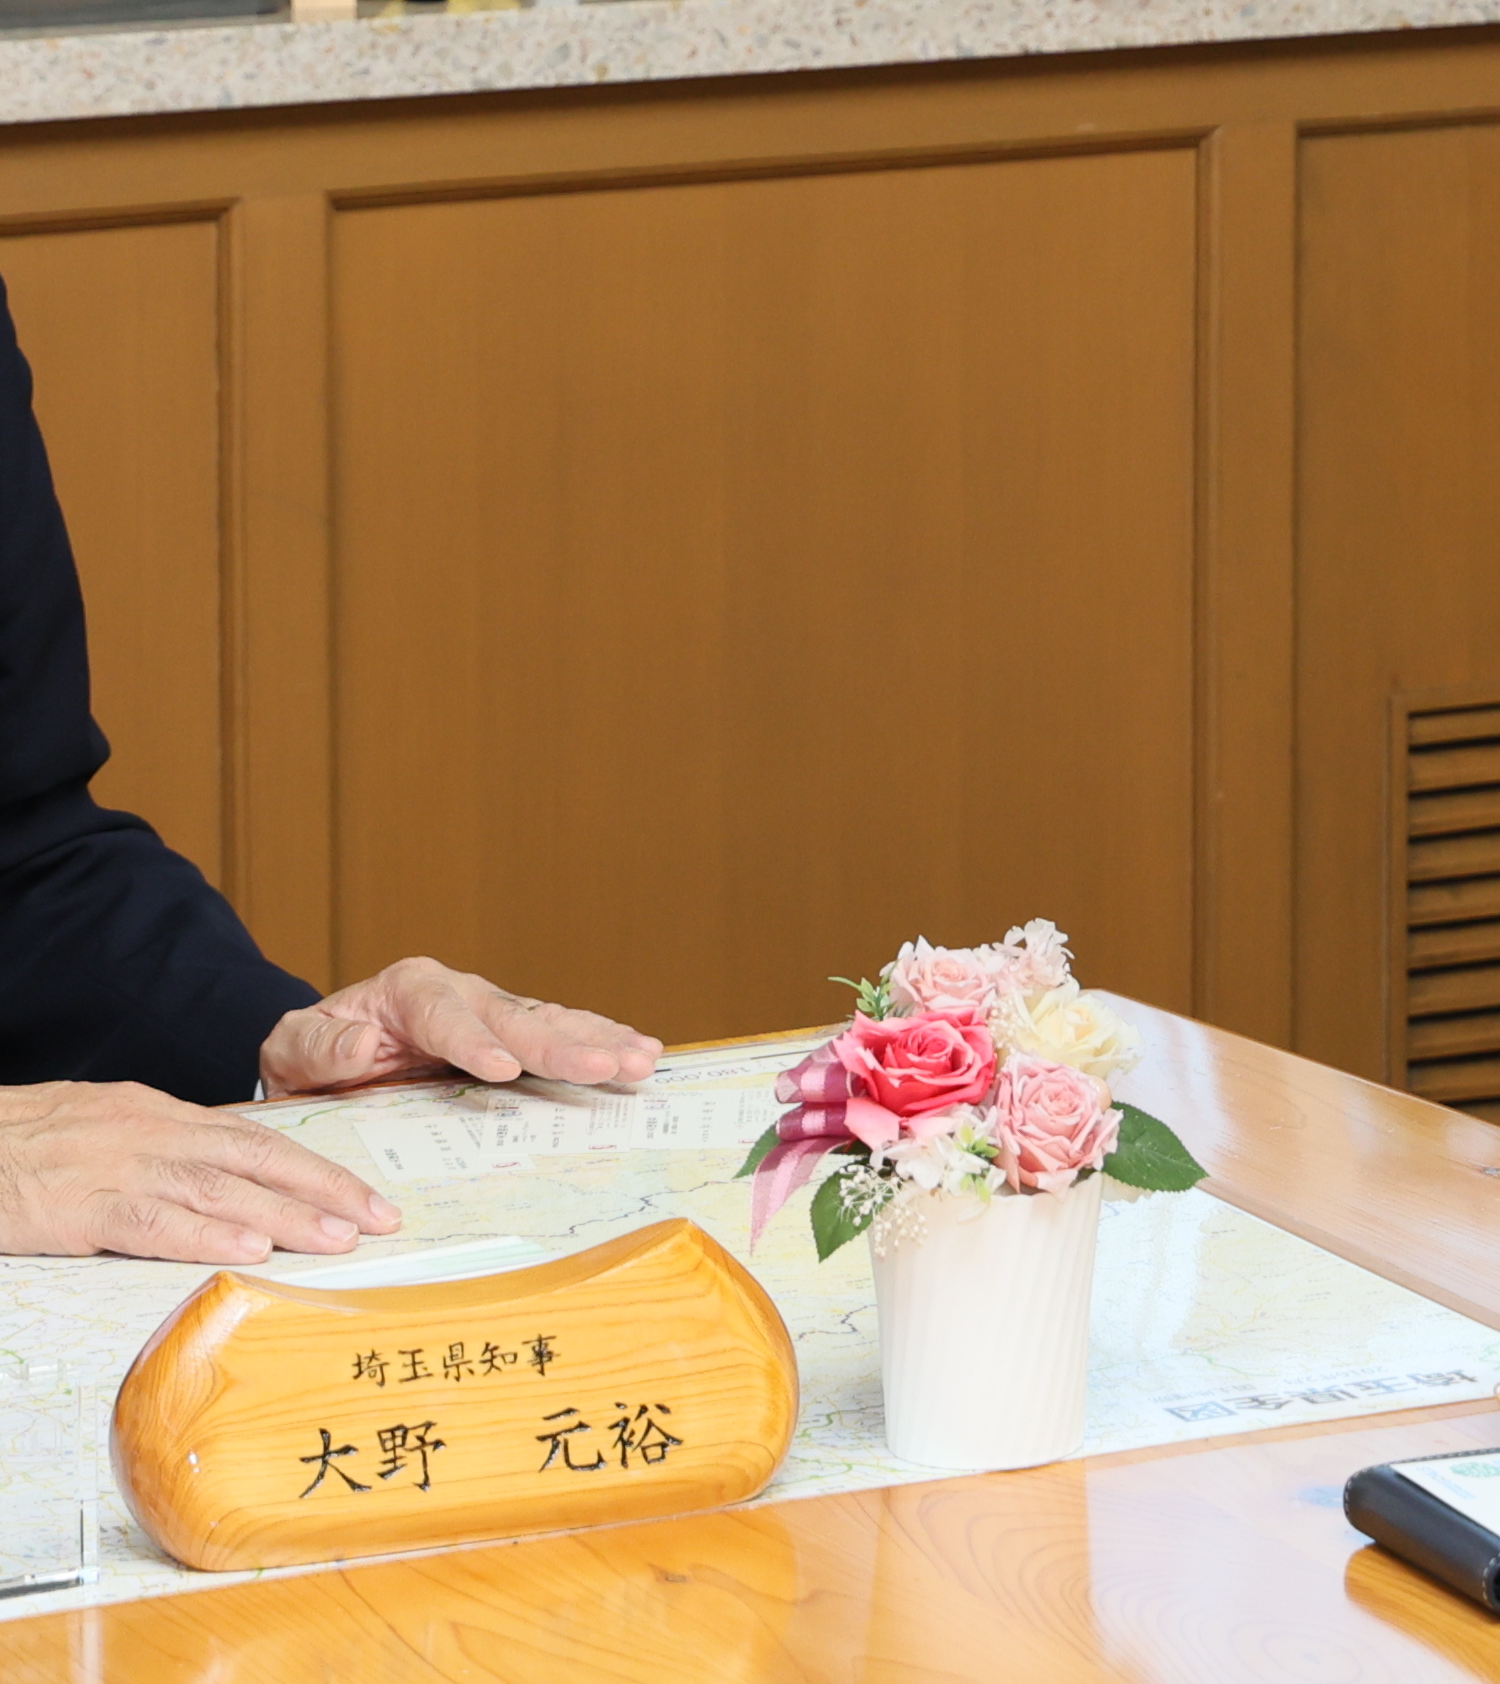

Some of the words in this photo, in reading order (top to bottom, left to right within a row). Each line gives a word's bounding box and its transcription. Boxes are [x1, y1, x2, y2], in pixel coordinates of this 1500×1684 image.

[351, 1333, 561, 1388] 埼玉県知事
[1163, 1368, 1480, 1423] 埼玉県全図
[298, 1419, 446, 1500] 大野
[535, 1401, 686, 1473] 元裕
